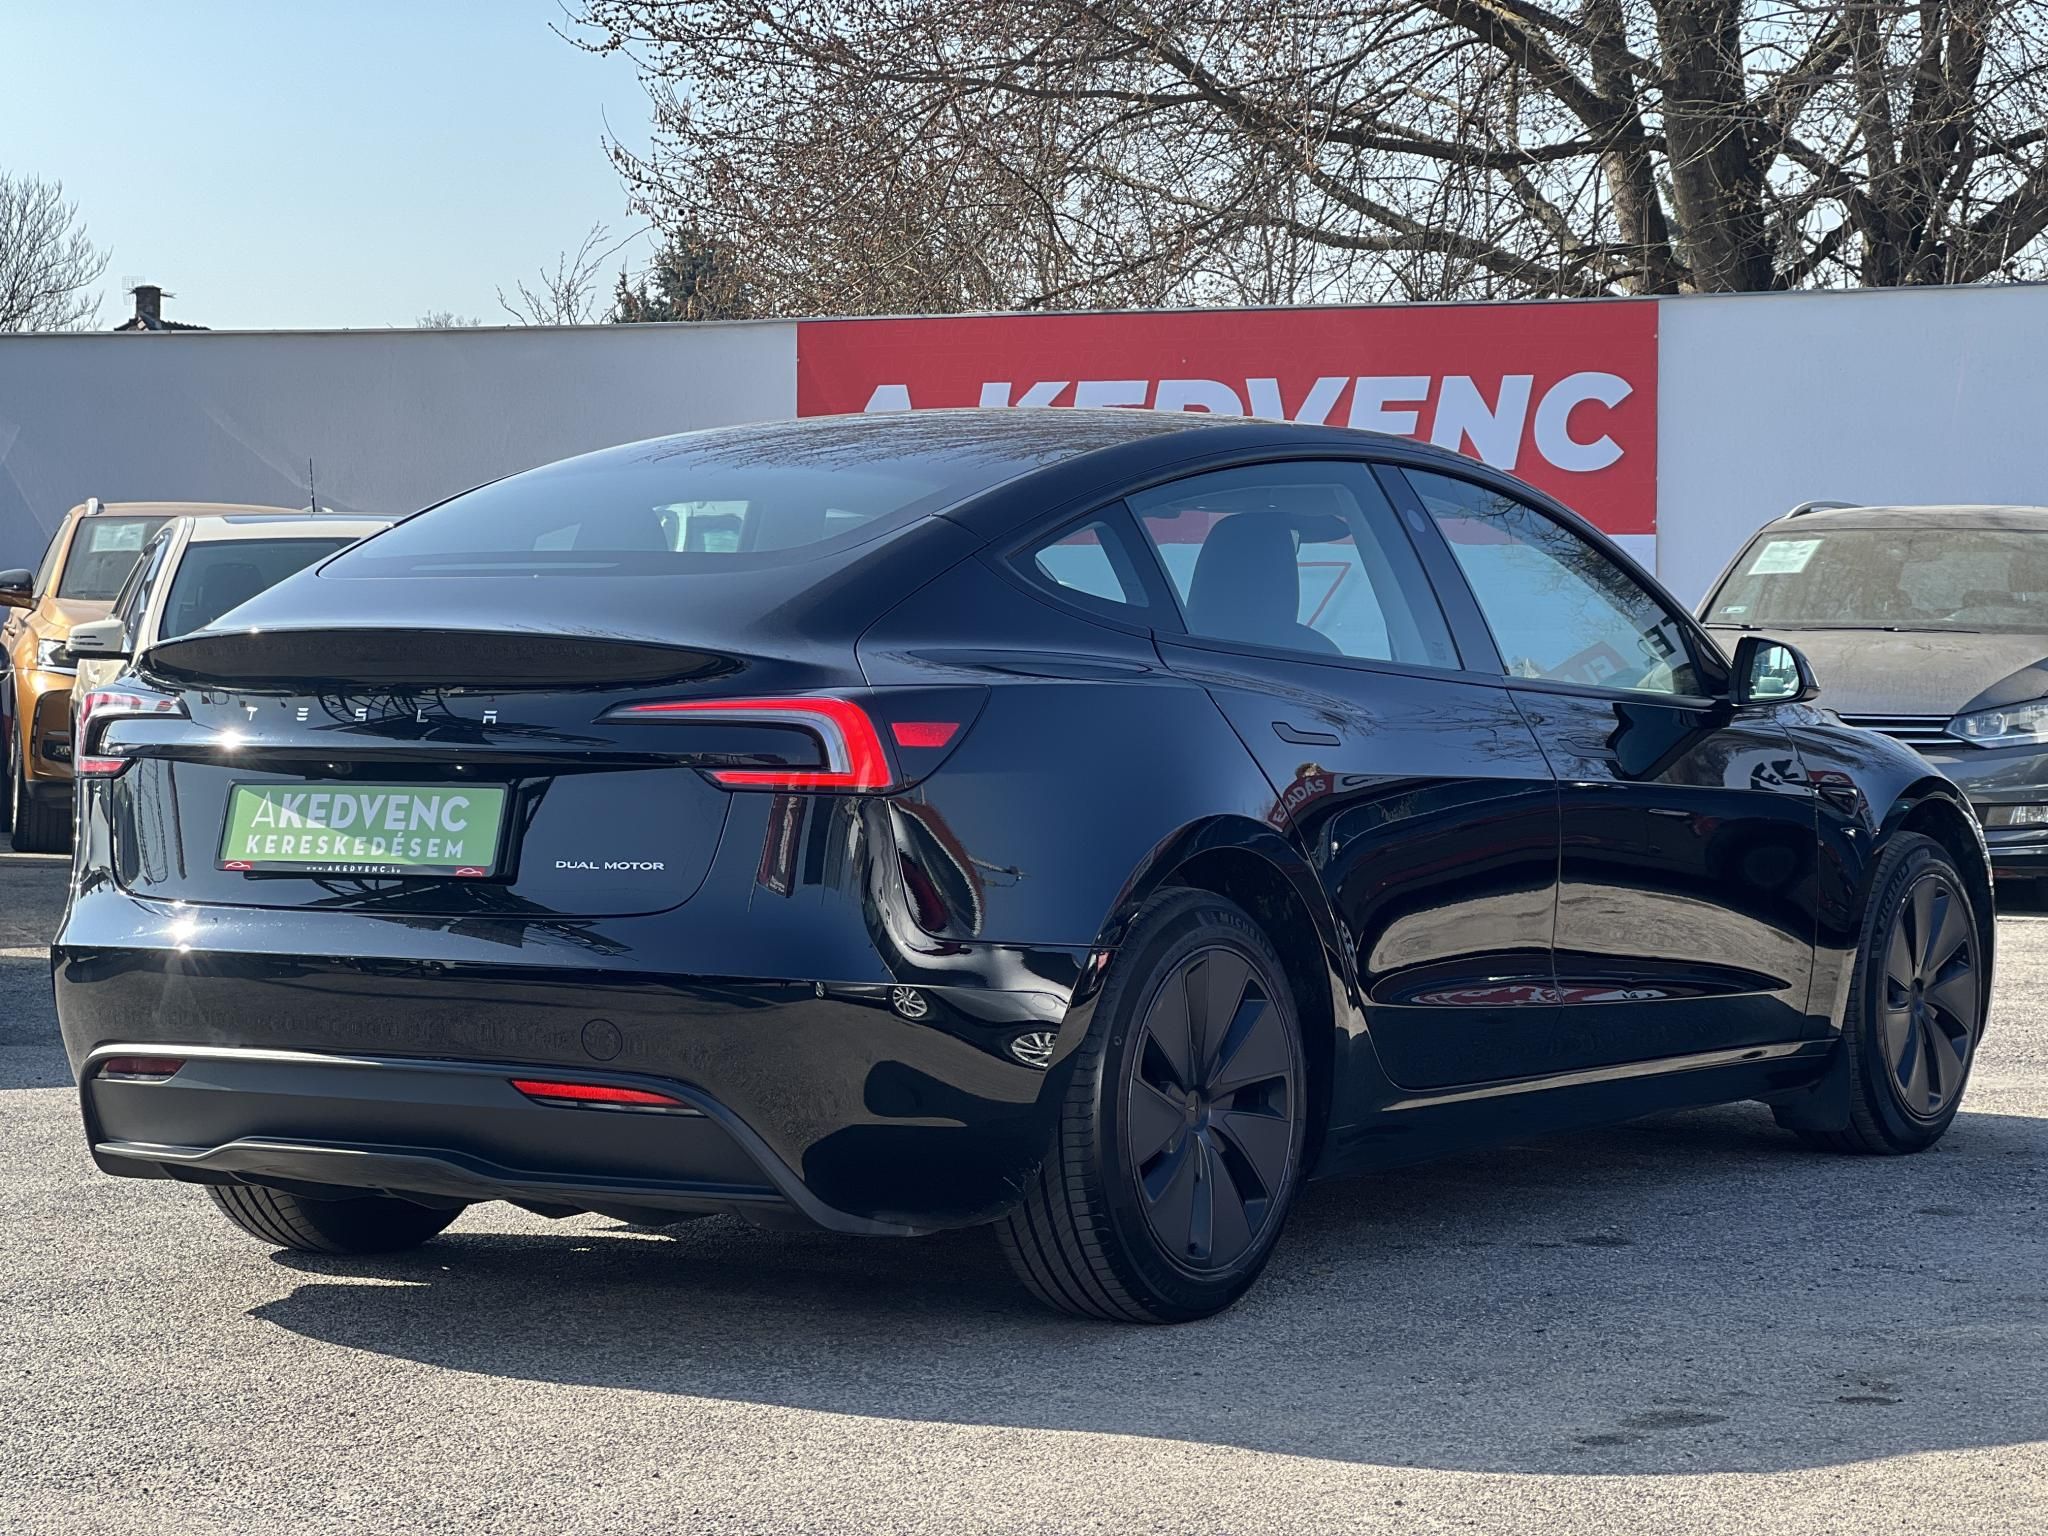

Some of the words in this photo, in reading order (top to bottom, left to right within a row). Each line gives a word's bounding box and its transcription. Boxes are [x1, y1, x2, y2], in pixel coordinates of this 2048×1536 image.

[979, 371, 1633, 472] VENC
[247, 706, 498, 725] TESLA
[245, 832, 465, 859] KERESKEDÉSEM
[555, 861, 600, 871] DUAL
[604, 861, 665, 871] MOTOR
